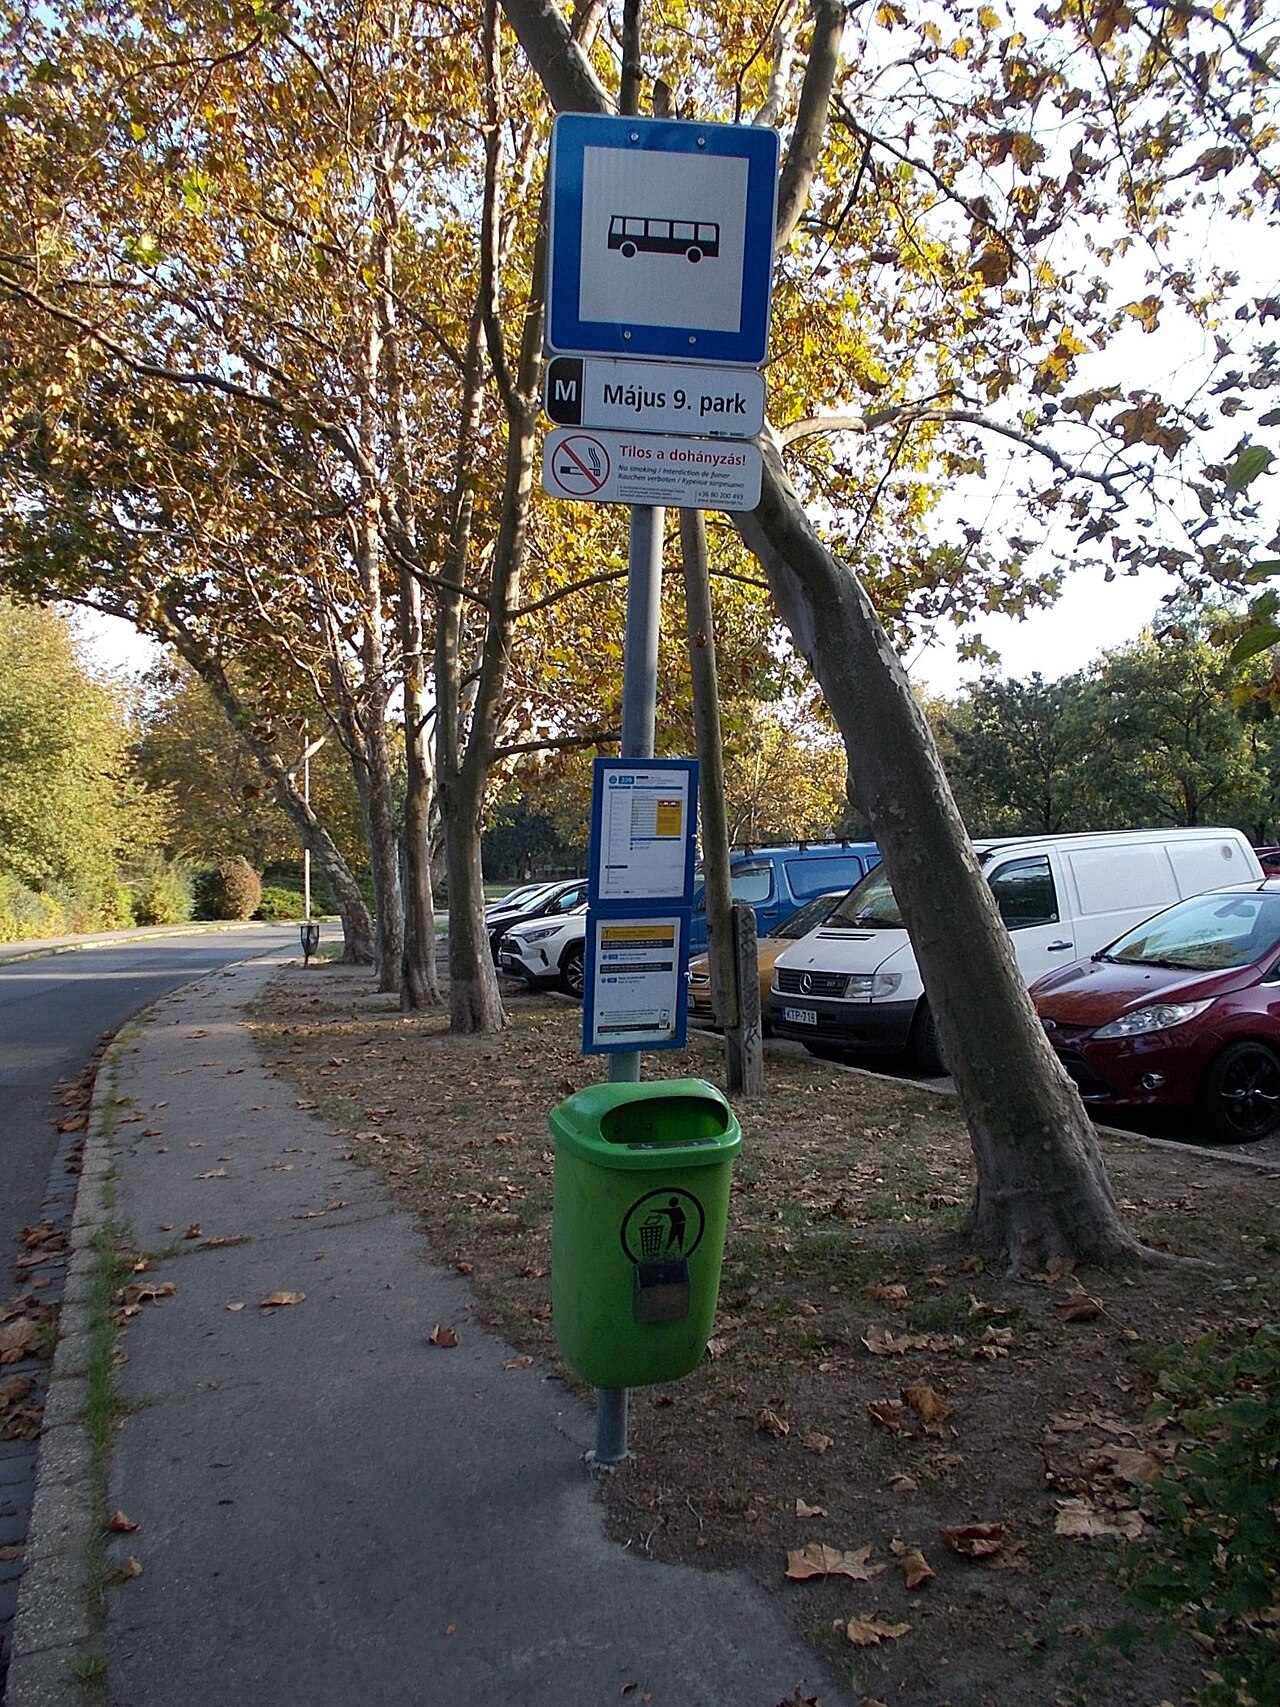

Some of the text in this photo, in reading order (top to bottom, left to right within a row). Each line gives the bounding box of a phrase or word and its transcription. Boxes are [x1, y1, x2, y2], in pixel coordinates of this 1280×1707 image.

[555, 379, 577, 402] M
[603, 384, 746, 416] Május 9. park
[619, 445, 746, 467] Tilos a dohányzás!
[618, 464, 628, 472] No
[630, 466, 657, 475] smoking
[663, 468, 699, 477] Interdiction
[701, 470, 709, 478] de
[618, 473, 646, 481] Rauchen
[647, 475, 676, 483] verboten
